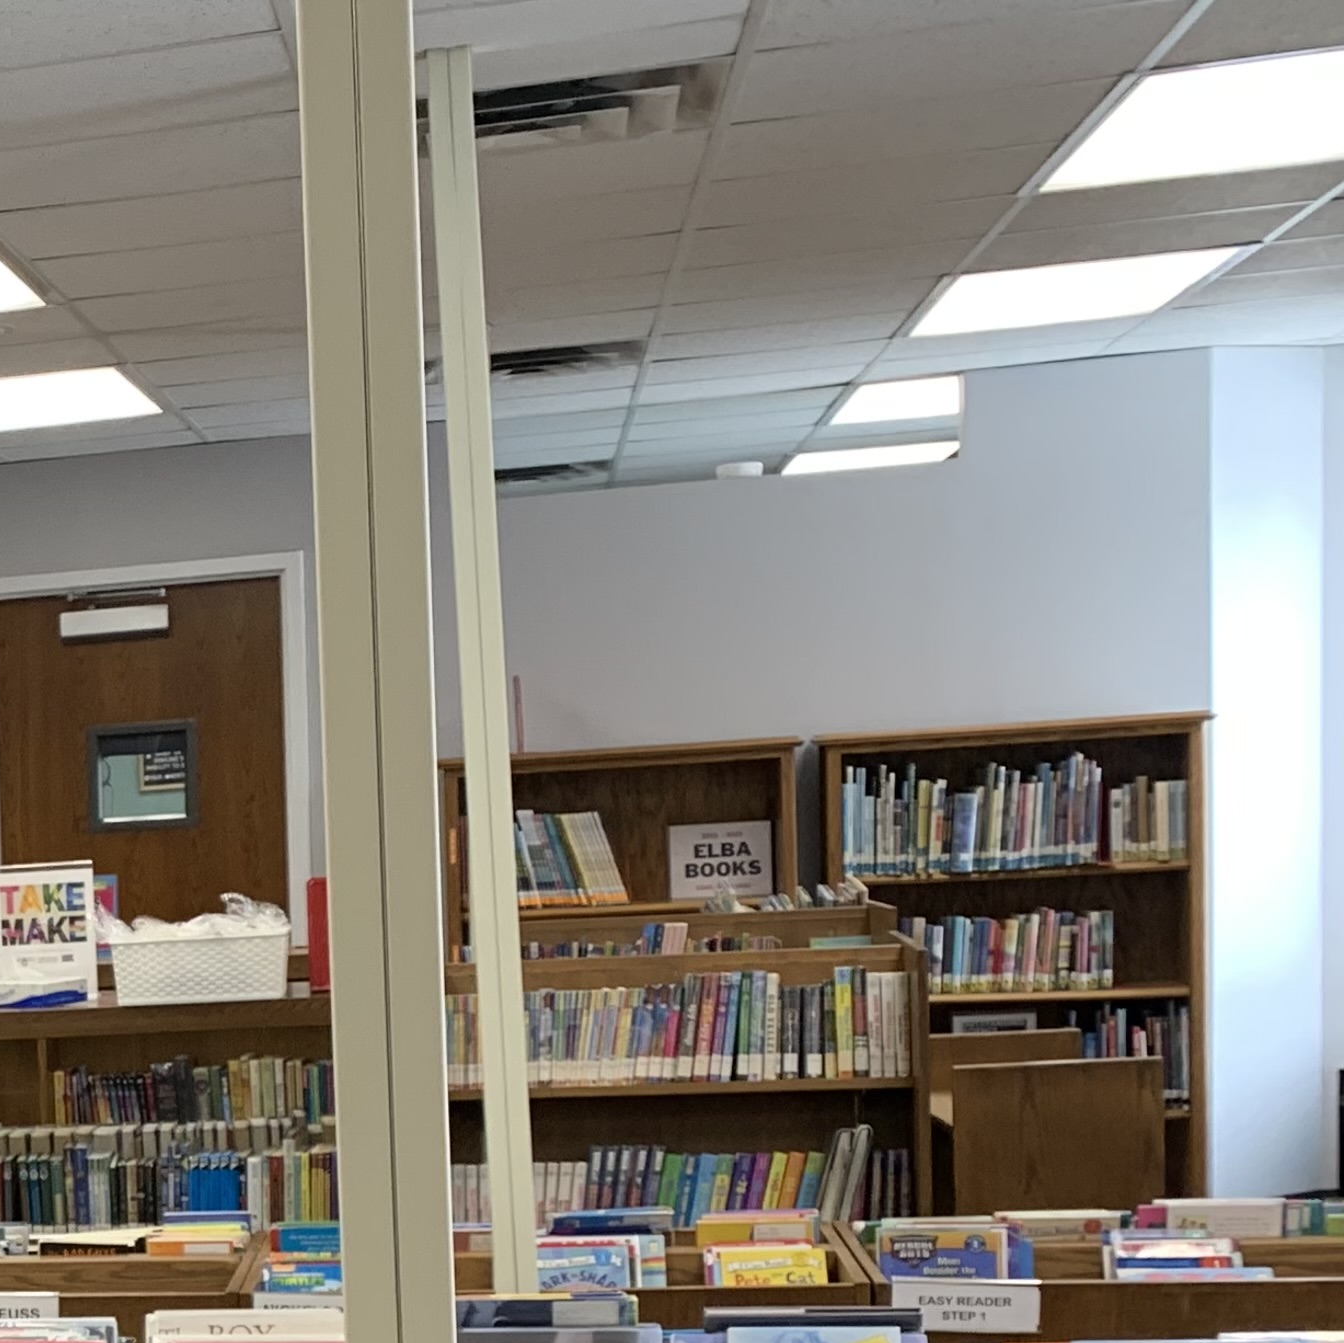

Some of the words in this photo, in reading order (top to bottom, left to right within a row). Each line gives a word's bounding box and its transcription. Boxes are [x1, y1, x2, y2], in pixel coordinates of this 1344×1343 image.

[694, 841, 751, 859] ELBA
[685, 860, 762, 879] BOOKS
[0, 882, 86, 915] TAKE
[1, 916, 88, 947] MAKE
[735, 1273, 771, 1286] Pete
[785, 1272, 816, 1286] Cat
[919, 1295, 954, 1307] EASY
[956, 1296, 1012, 1308] READER
[942, 1310, 978, 1321] STEP
[981, 1311, 987, 1322] 1
